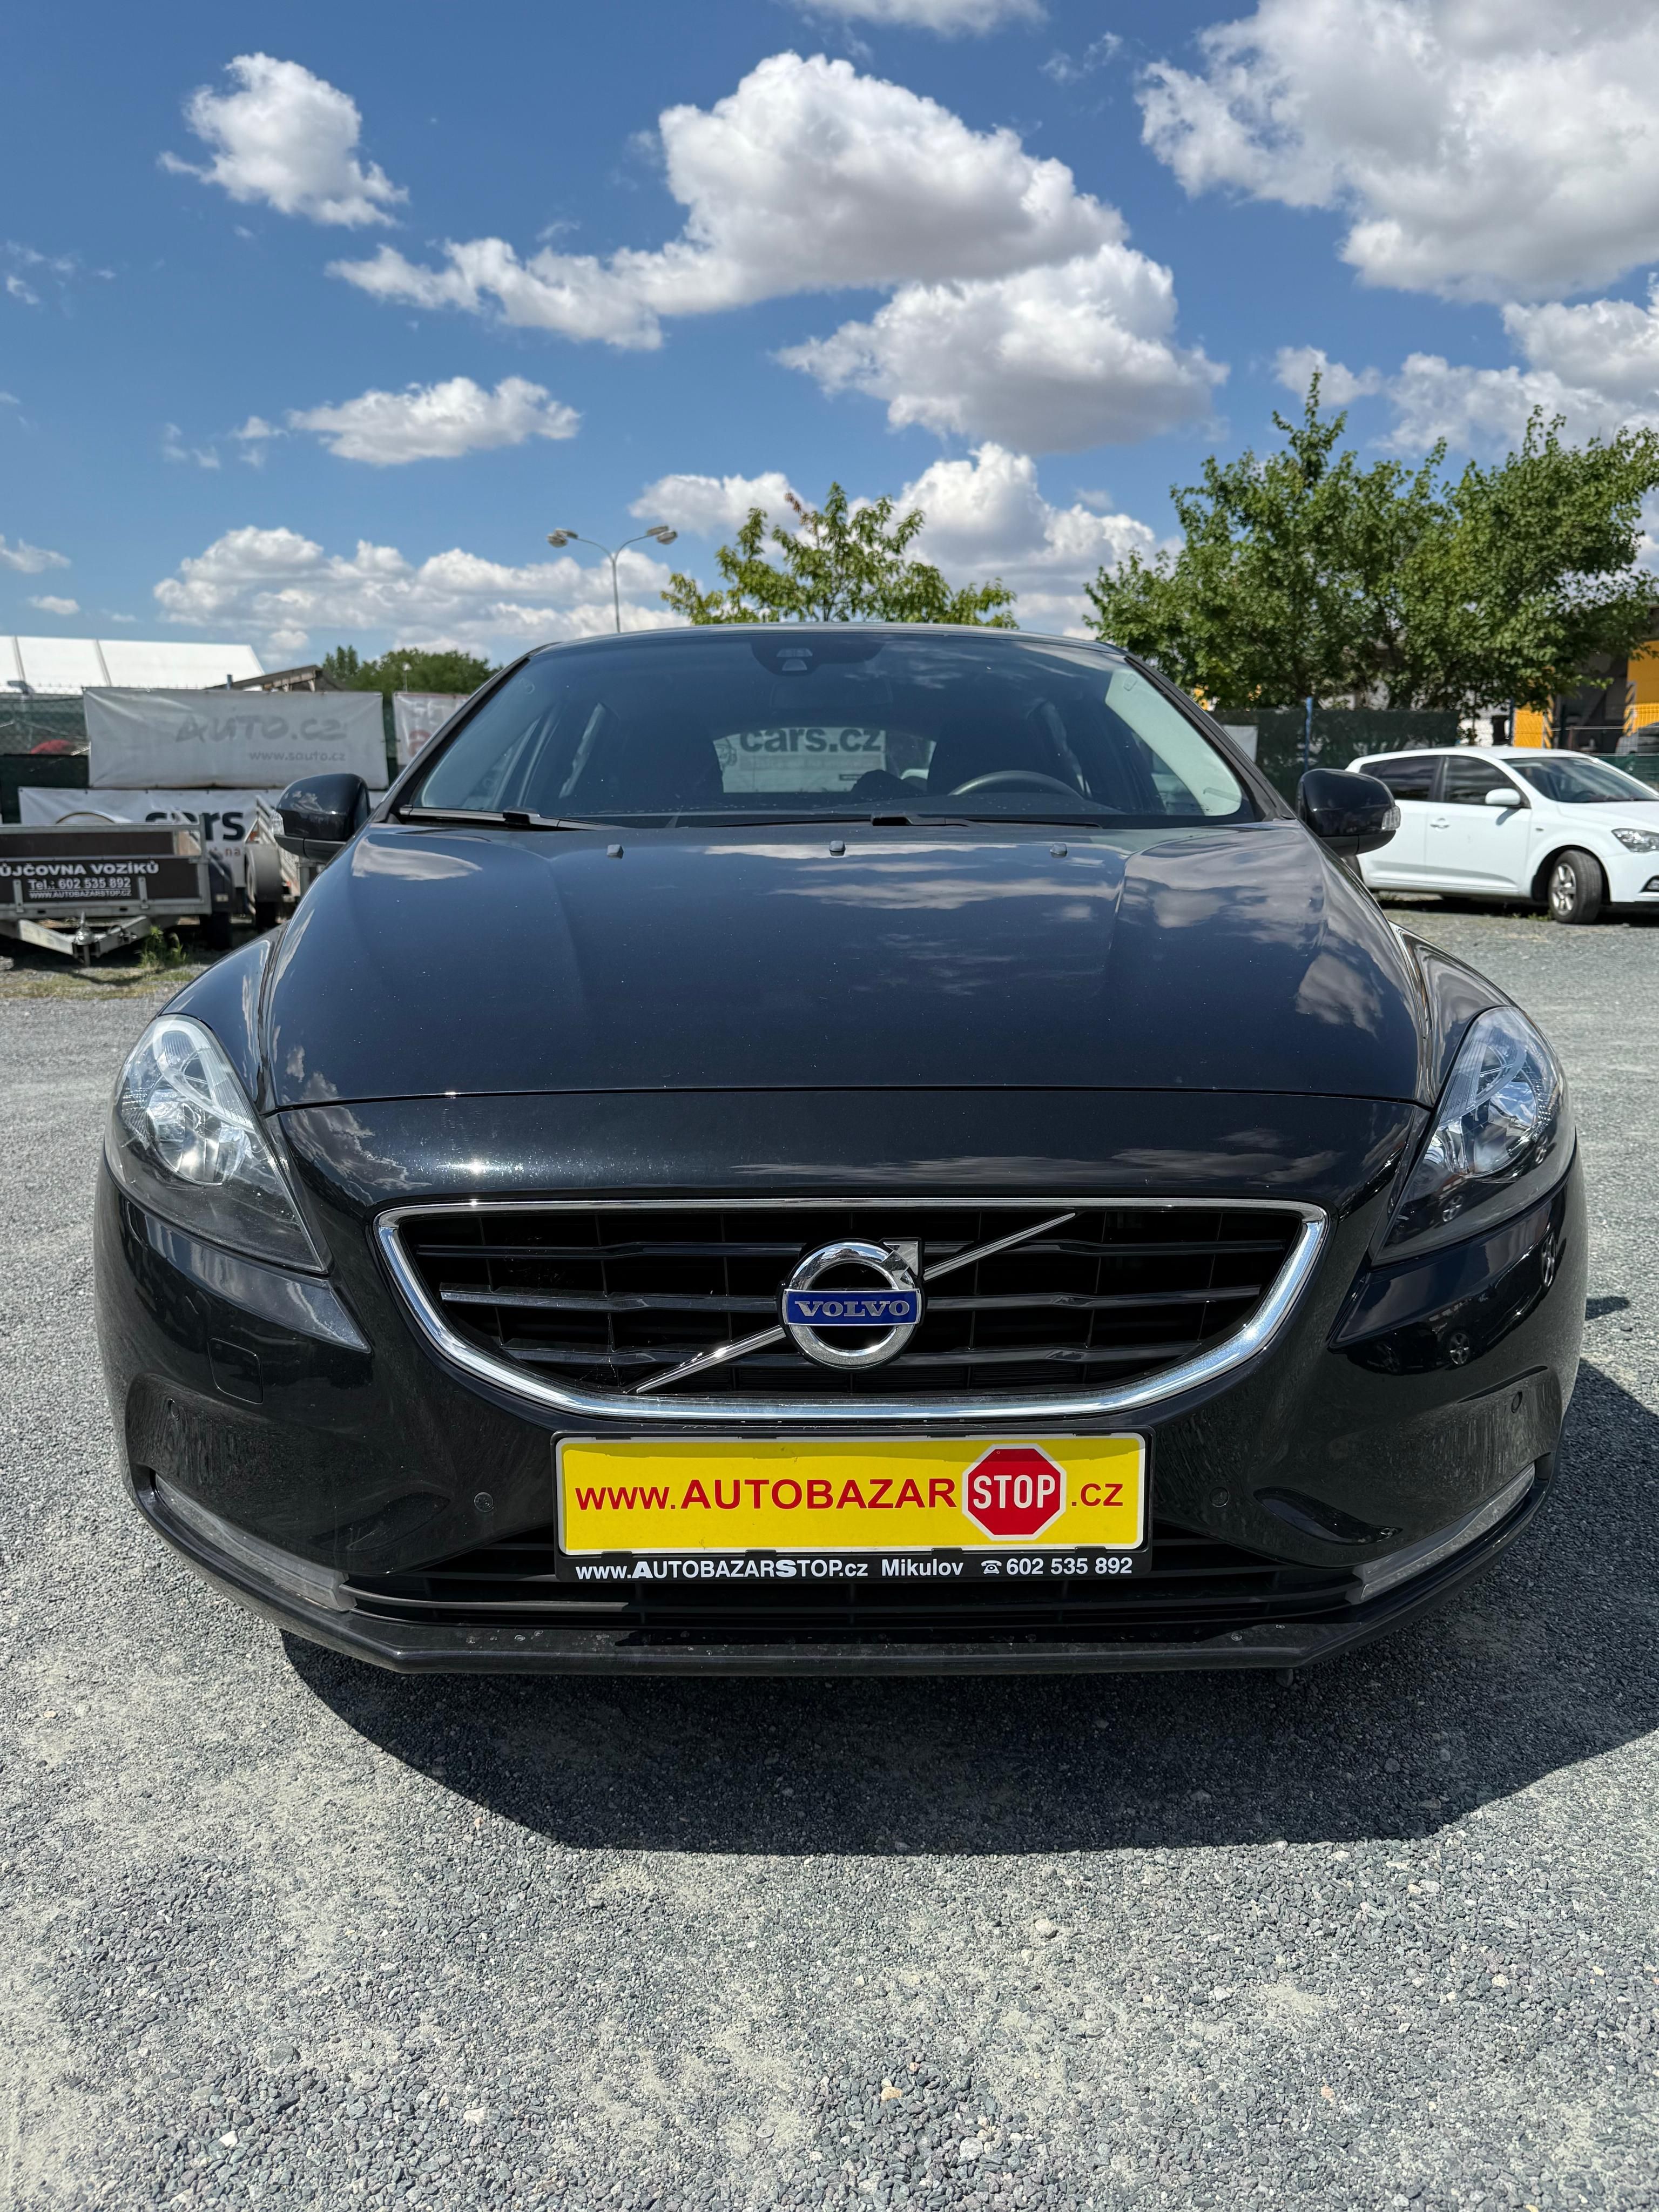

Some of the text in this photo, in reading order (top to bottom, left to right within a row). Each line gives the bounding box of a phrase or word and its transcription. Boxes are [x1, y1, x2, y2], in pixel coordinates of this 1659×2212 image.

[740, 728, 881, 752] cars.cz
[249, 750, 346, 761] www.sauto.cz
[90, 860, 159, 874] VOZÍKŮ
[28, 876, 131, 890] Tel.: 602 535 892
[29, 889, 132, 899] WWW.AUTOBAZARSTOP.CZ
[794, 1300, 910, 1317] VOLVO
[973, 1474, 1055, 1509] STOP
[881, 1559, 964, 1576] Mikulov
[1006, 1558, 1043, 1575] 602
[1050, 1558, 1088, 1575] 535
[1094, 1557, 1133, 1574] 892
